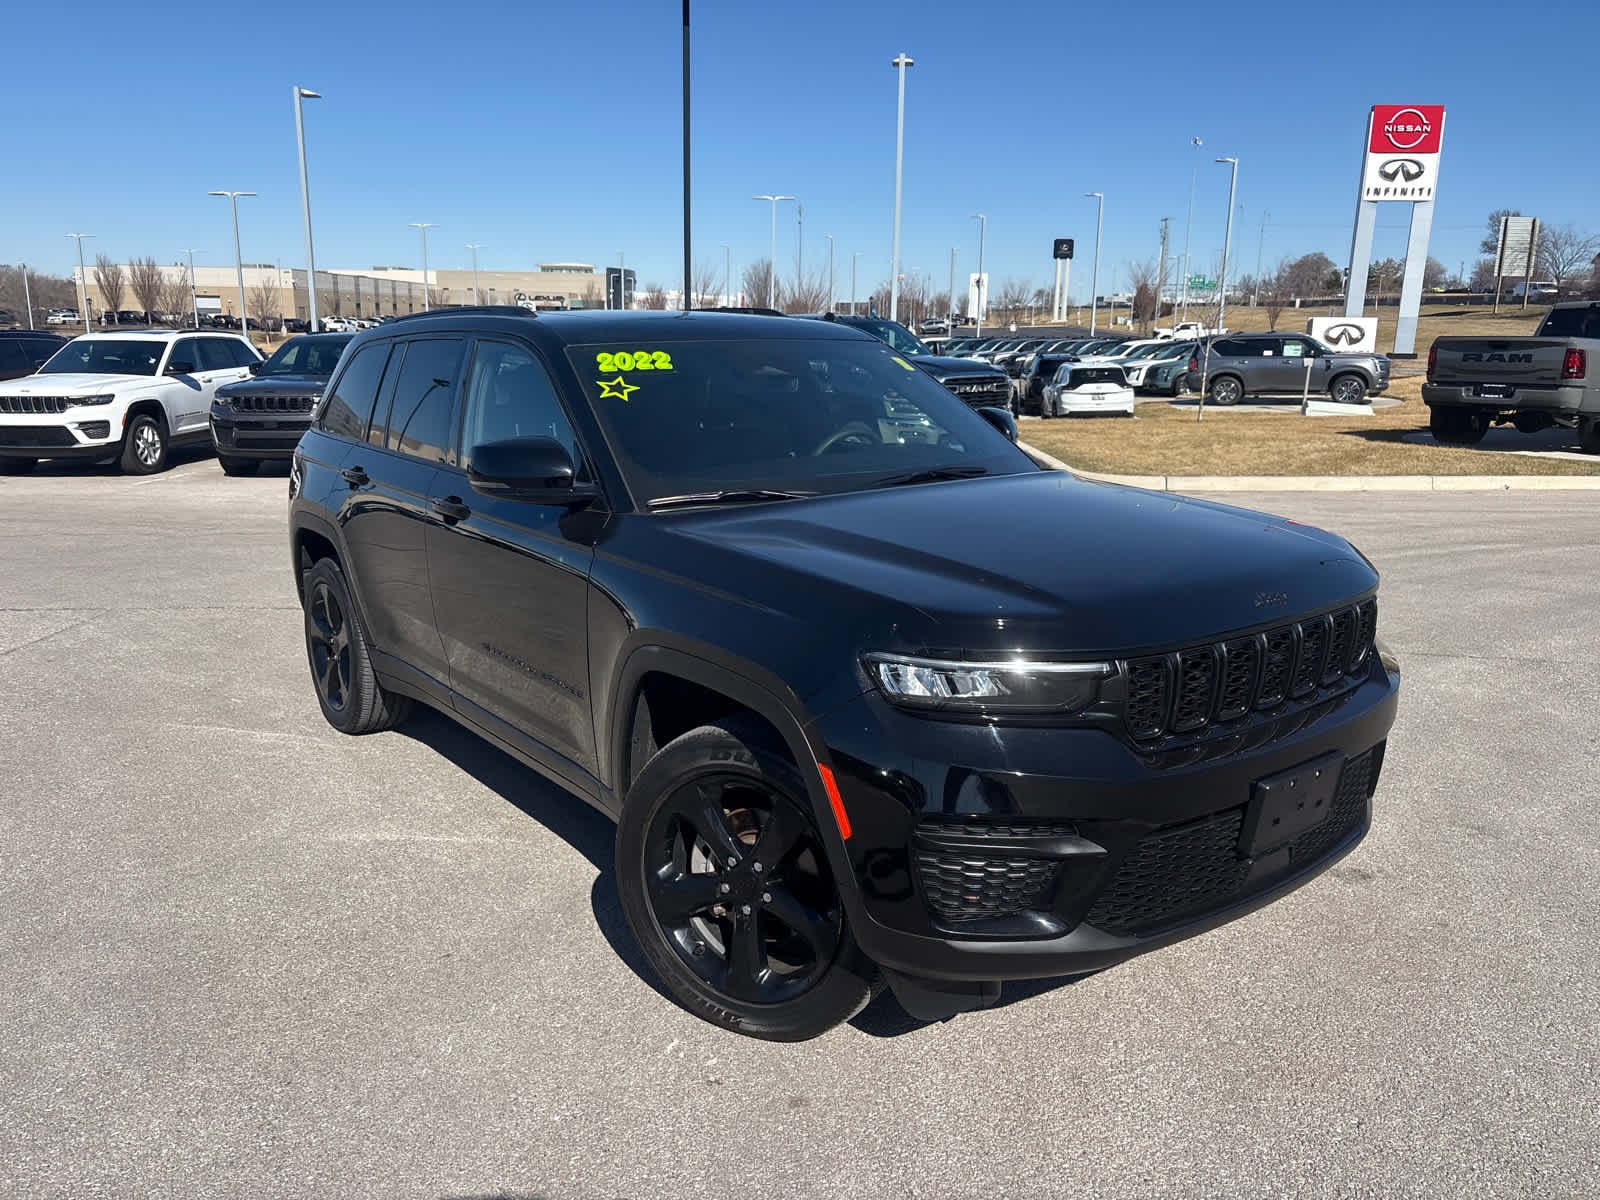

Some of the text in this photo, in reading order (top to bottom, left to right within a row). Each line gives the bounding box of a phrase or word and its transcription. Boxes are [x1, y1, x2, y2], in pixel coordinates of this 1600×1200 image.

[1384, 124, 1431, 132] NISSAN
[1366, 186, 1432, 197] INFINITI
[596, 351, 673, 372] 2022
[1462, 353, 1533, 363] RAM
[960, 384, 997, 393] RAM
